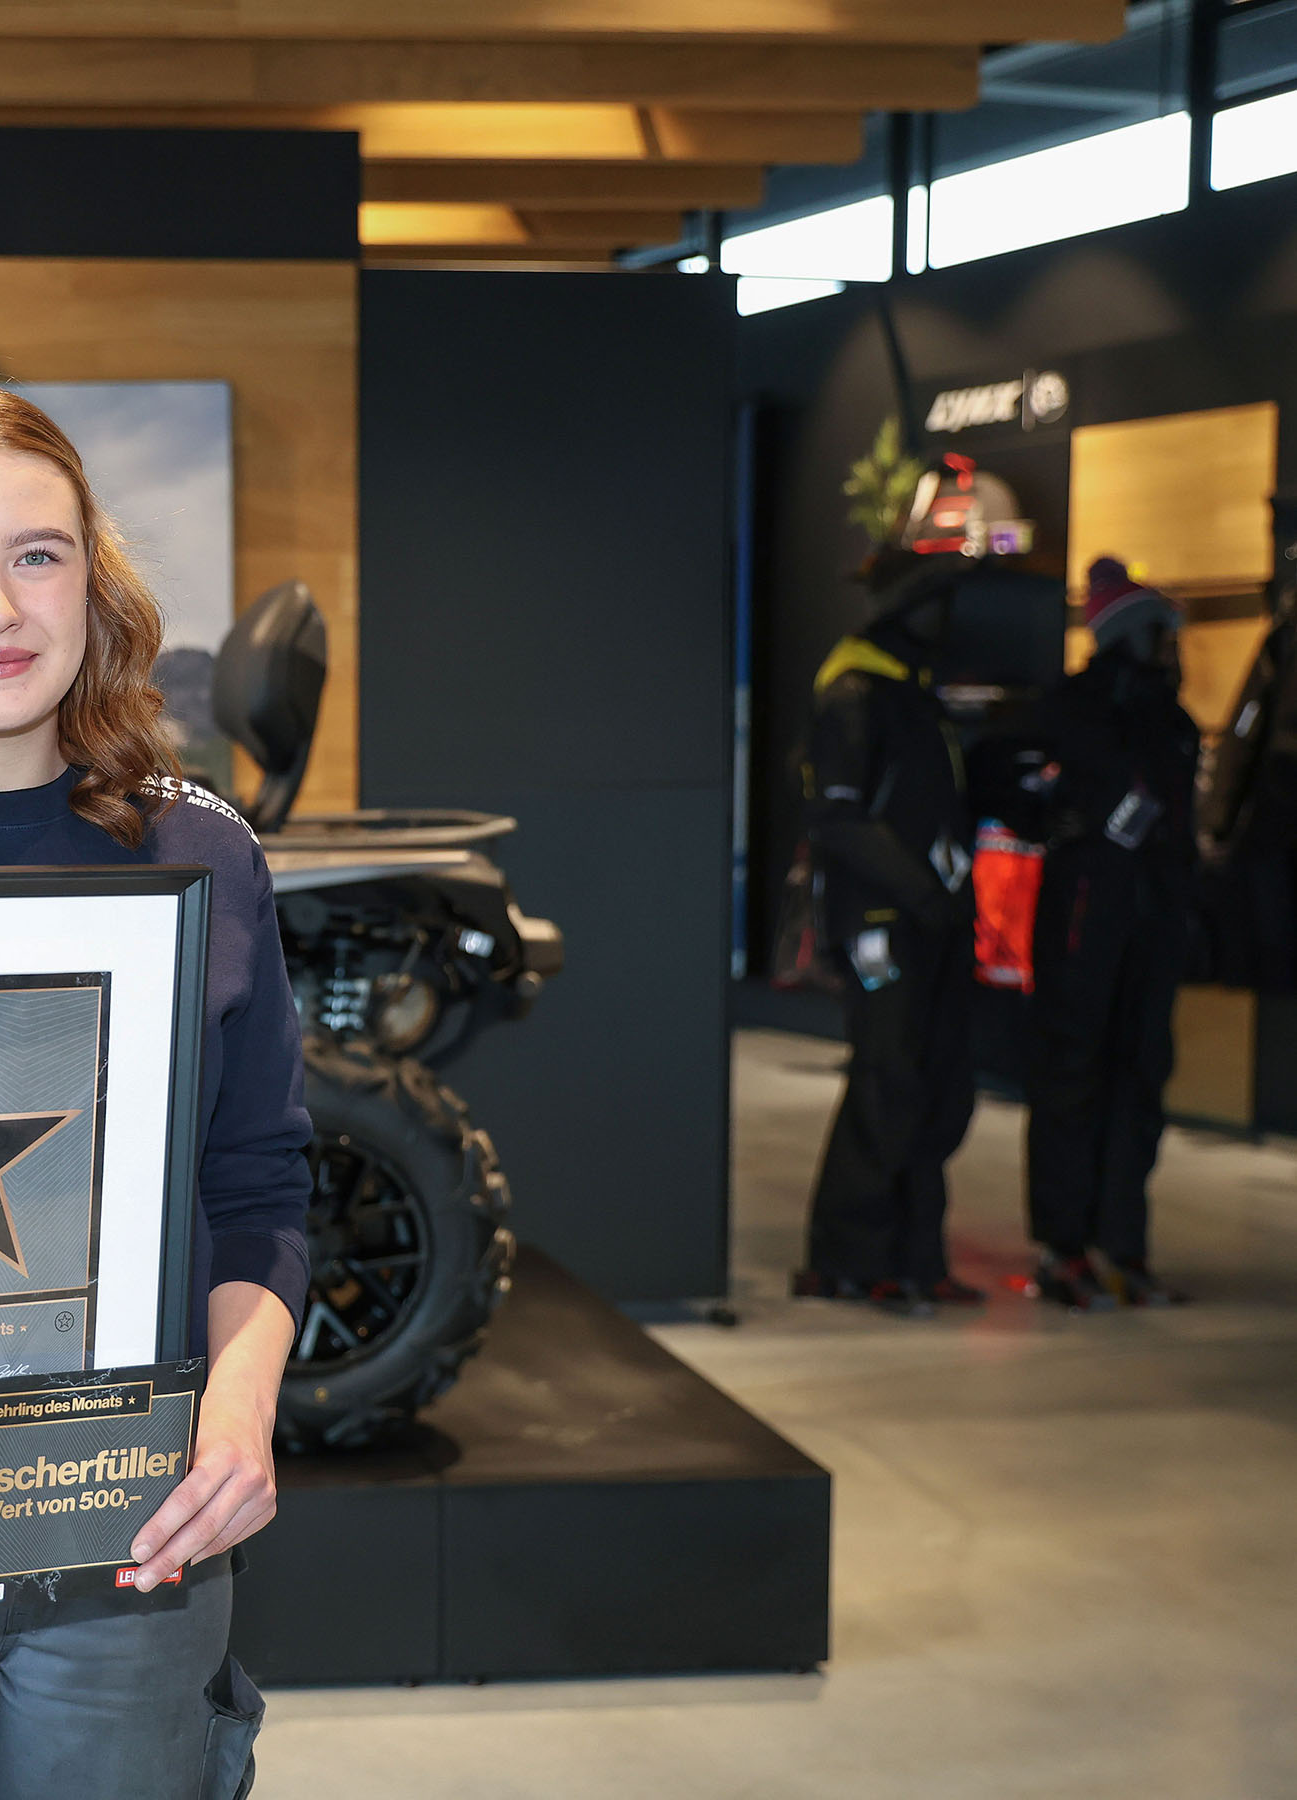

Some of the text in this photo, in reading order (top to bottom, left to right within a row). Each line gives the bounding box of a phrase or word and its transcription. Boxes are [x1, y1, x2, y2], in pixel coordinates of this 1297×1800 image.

[45, 1400, 71, 1413] des
[72, 1395, 123, 1412] Monats
[37, 1496, 76, 1516] von
